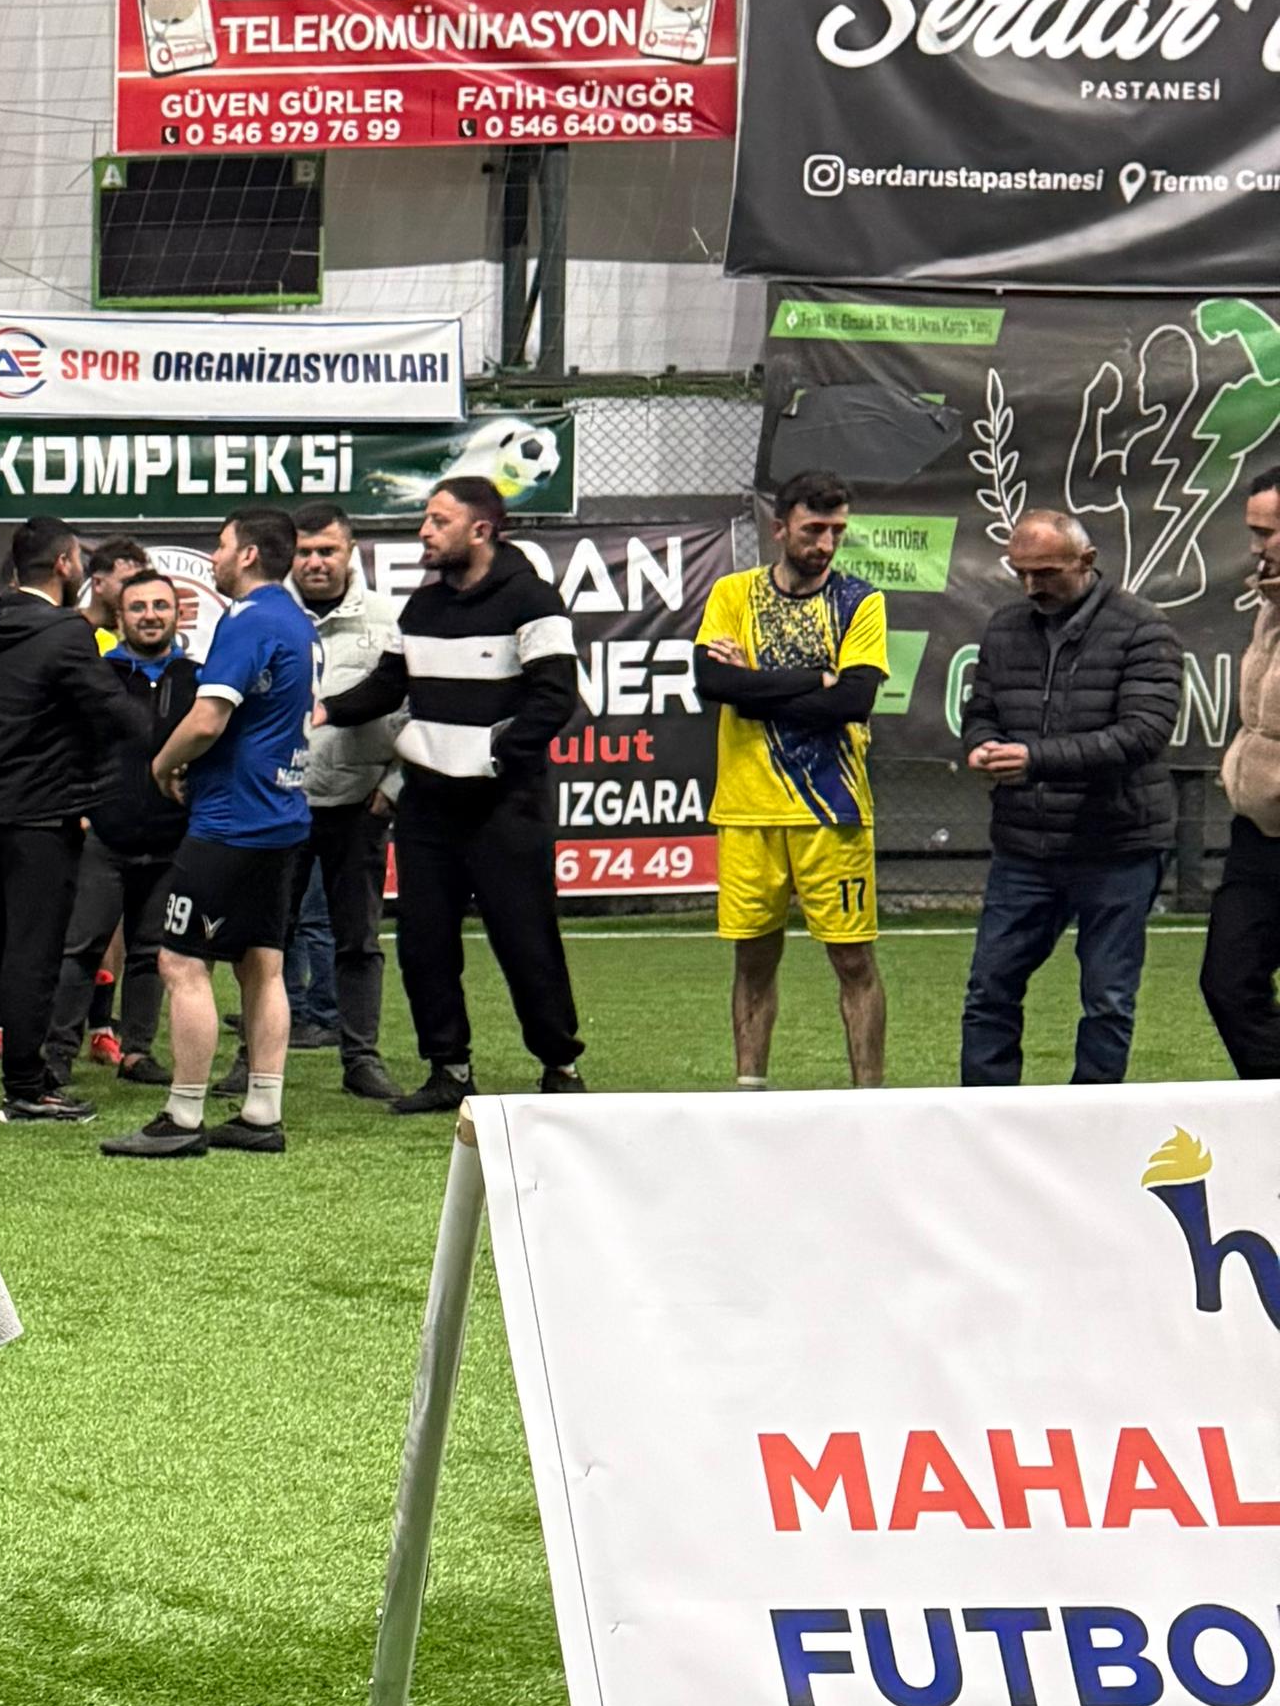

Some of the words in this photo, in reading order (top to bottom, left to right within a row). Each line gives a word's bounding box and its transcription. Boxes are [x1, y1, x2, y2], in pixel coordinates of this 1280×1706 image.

[219, 4, 637, 56] TELEKOMÜNİKASYON
[160, 90, 269, 120] GÜVEN
[279, 86, 405, 117] GÜRLER
[457, 81, 545, 111] FATİH
[554, 75, 695, 109] GÜNGÖR
[1080, 78, 1221, 101] PASTANESİ
[185, 123, 205, 145] 0
[212, 122, 263, 144] 546
[269, 121, 323, 142] 979
[327, 120, 360, 141] 76
[366, 119, 402, 141] 99
[484, 118, 505, 138] 0
[509, 116, 559, 137] 546
[563, 115, 616, 135] 640
[621, 114, 658, 134] 00
[661, 113, 694, 133] 55
[101, 164, 124, 188] A
[846, 165, 1104, 192] serdarustapastanesi
[1150, 169, 1228, 192] Terme
[60, 350, 140, 381] SPOR
[152, 345, 450, 383] ORGANİZASYONLARI
[575, 639, 703, 716] NER
[548, 726, 654, 764] ulut
[558, 778, 705, 827] IZGARA
[589, 847, 635, 881] 74
[643, 845, 694, 879] 49
[838, 877, 866, 914] 17
